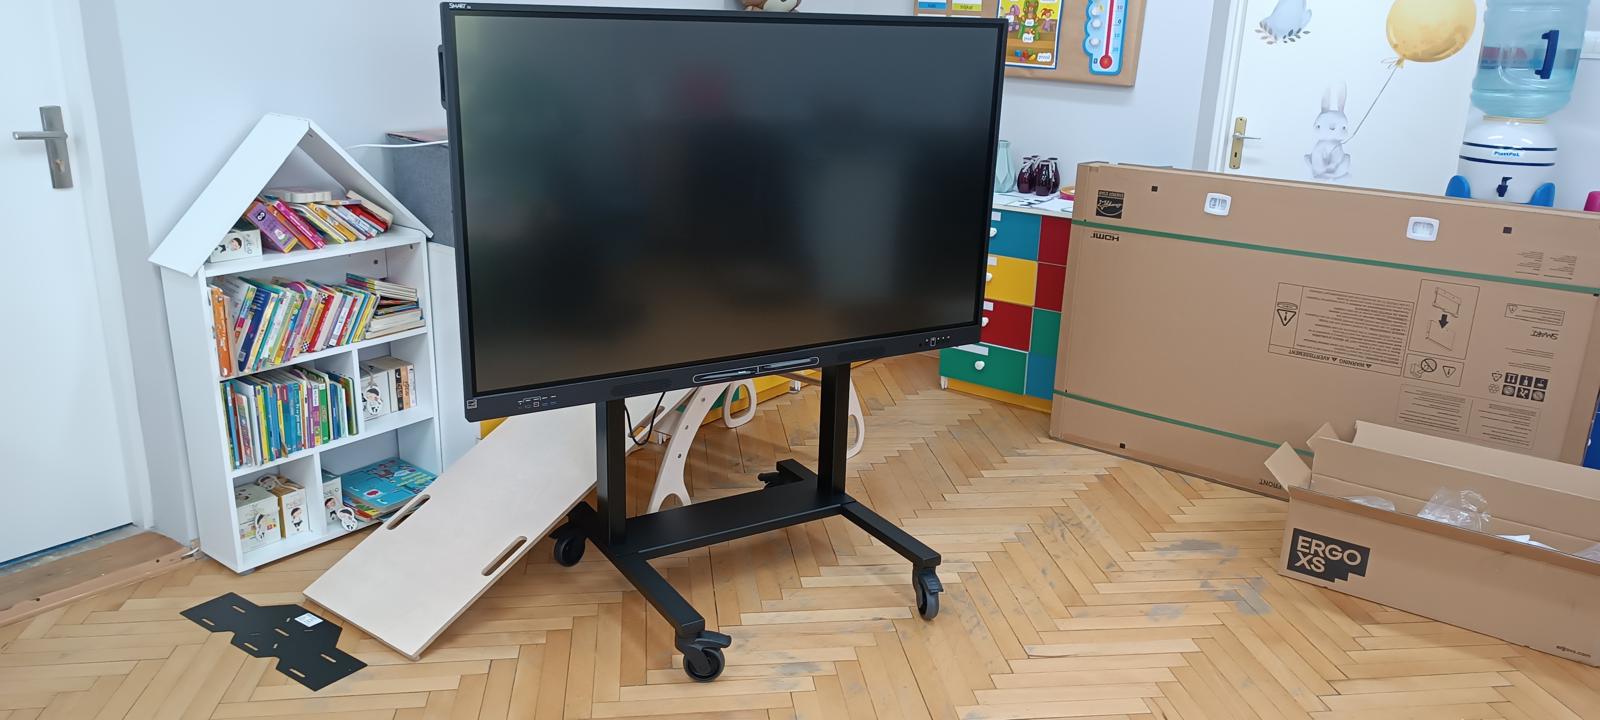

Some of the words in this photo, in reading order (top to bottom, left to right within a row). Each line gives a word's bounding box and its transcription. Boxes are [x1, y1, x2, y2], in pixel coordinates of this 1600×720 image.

[1092, 233, 1120, 242] HDMI
[1531, 330, 1558, 340] SMART
[1339, 359, 1365, 368] WARNING
[1296, 535, 1362, 567] ERGO
[1294, 552, 1326, 573] XS
